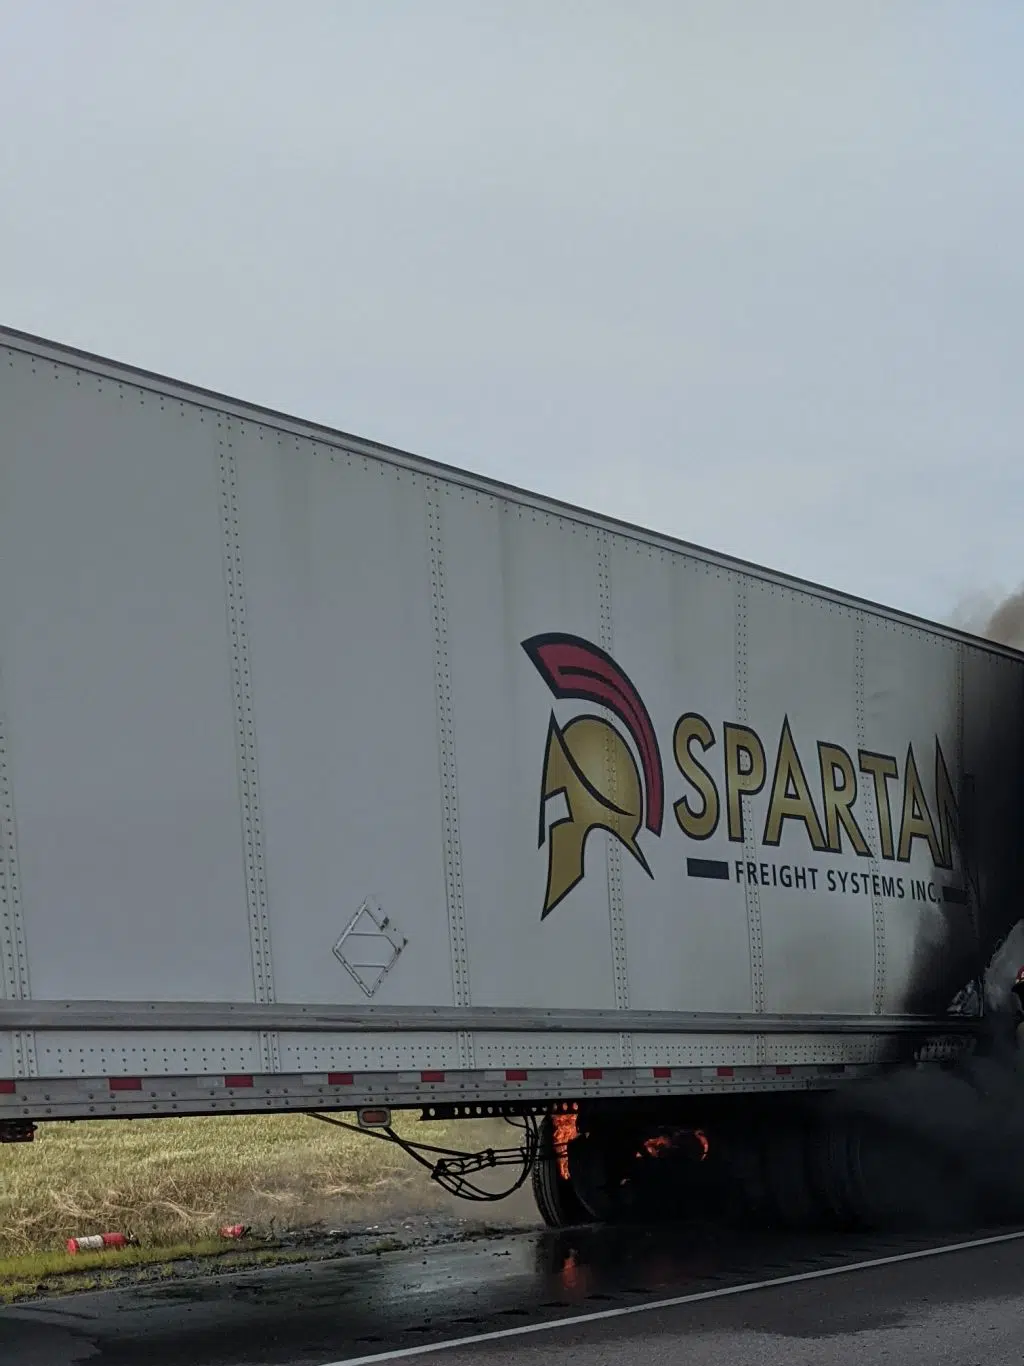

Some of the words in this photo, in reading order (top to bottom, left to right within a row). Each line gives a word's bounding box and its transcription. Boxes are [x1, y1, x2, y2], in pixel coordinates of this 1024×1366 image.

[735, 861, 818, 891] FREIGHT
[827, 869, 905, 899] SYSTEMS
[911, 880, 941, 903] INC.
